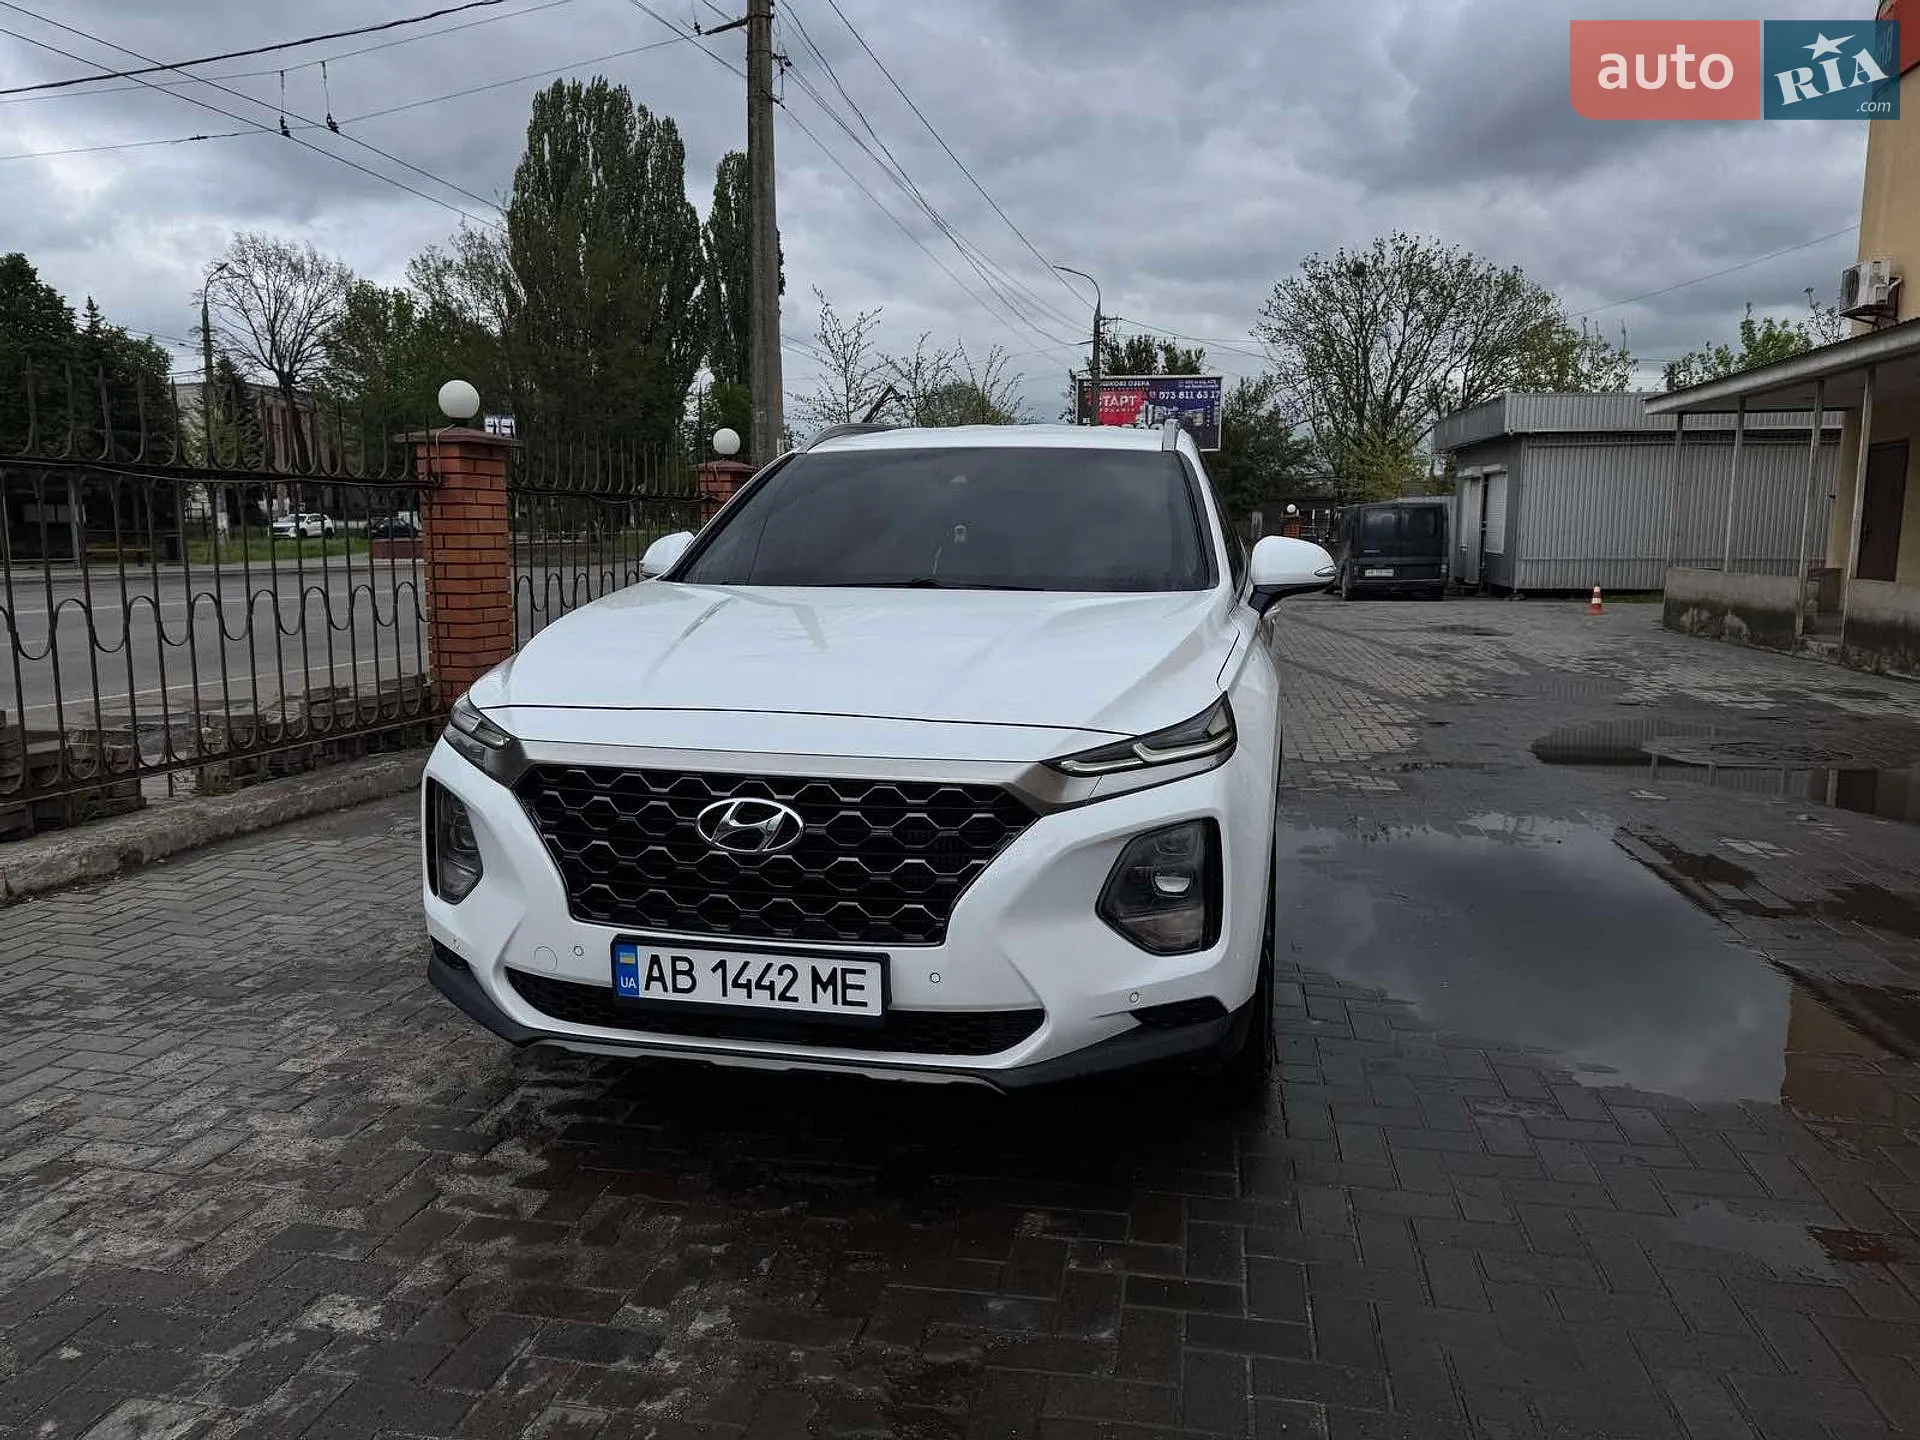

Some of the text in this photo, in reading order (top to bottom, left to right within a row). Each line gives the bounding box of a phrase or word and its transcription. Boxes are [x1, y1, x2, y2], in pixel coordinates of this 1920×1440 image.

[1159, 390, 1176, 399] 073
[1179, 390, 1194, 399] 811
[621, 976, 637, 989] UA
[644, 954, 868, 1007] AB 1442 ME
